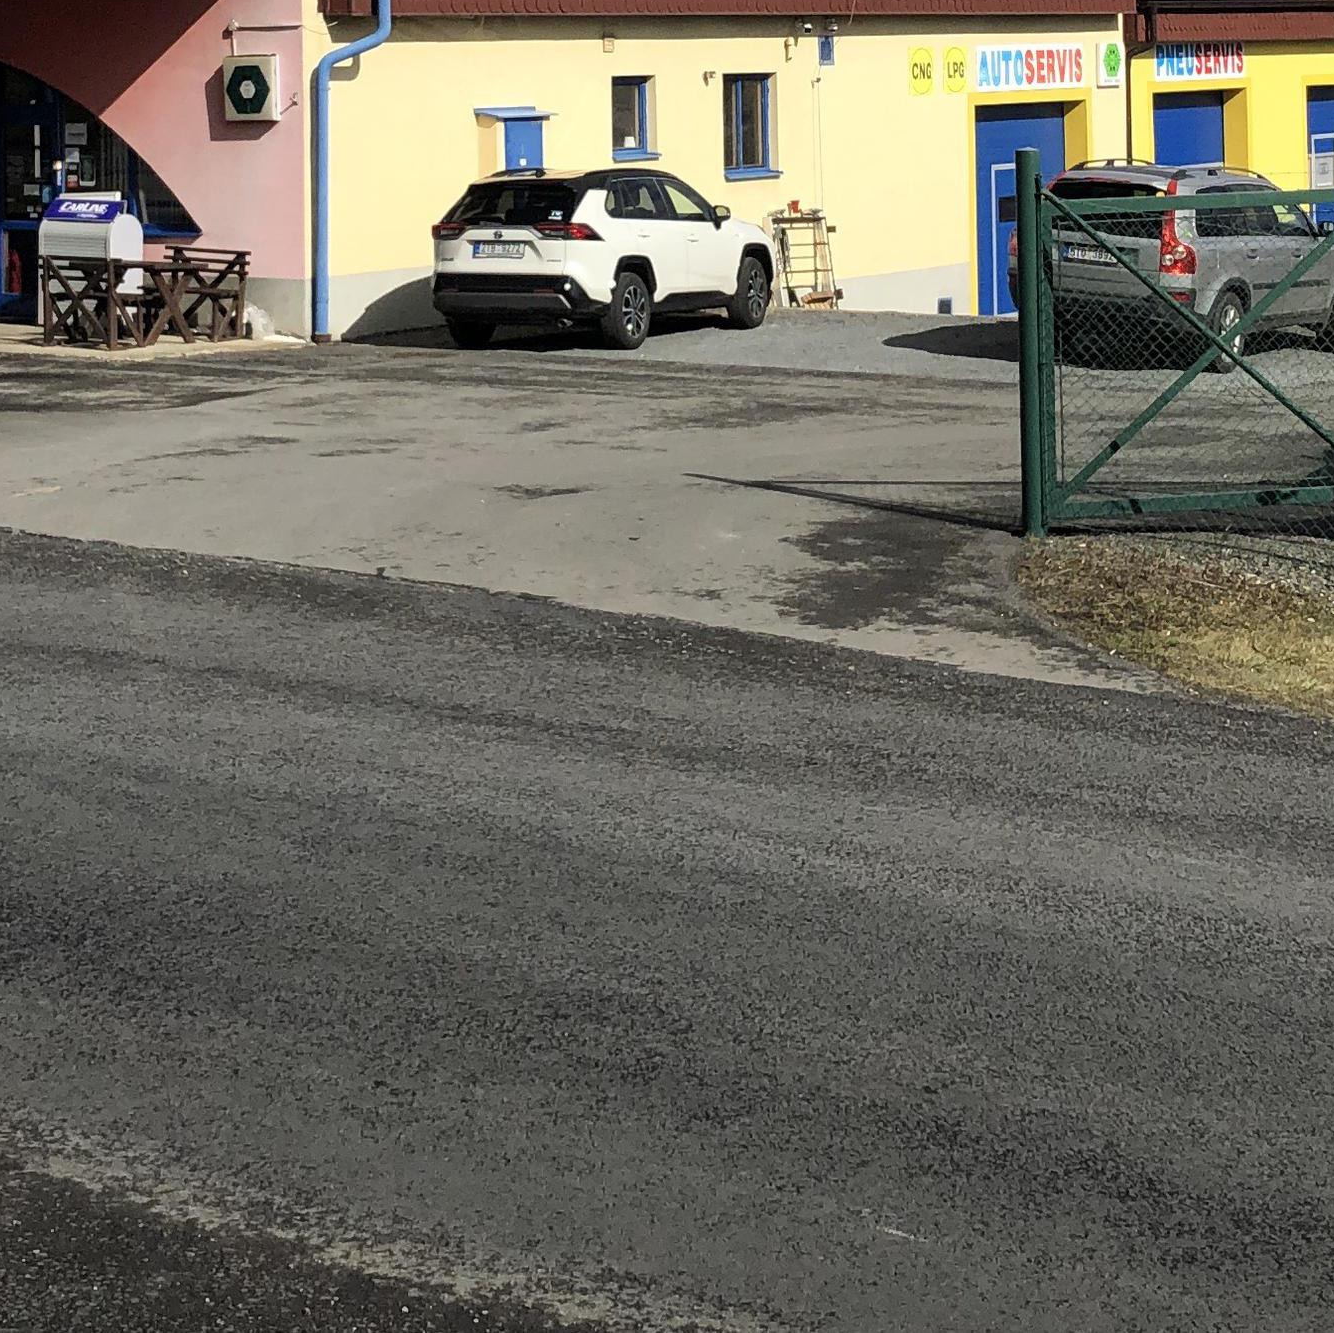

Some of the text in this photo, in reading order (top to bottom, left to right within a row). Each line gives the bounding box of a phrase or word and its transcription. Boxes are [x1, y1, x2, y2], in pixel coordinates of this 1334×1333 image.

[911, 61, 932, 80] CNG
[947, 61, 965, 79] LPG
[978, 48, 1083, 87] AUTOSERVIS
[1155, 41, 1244, 76] PNEUSERVIS
